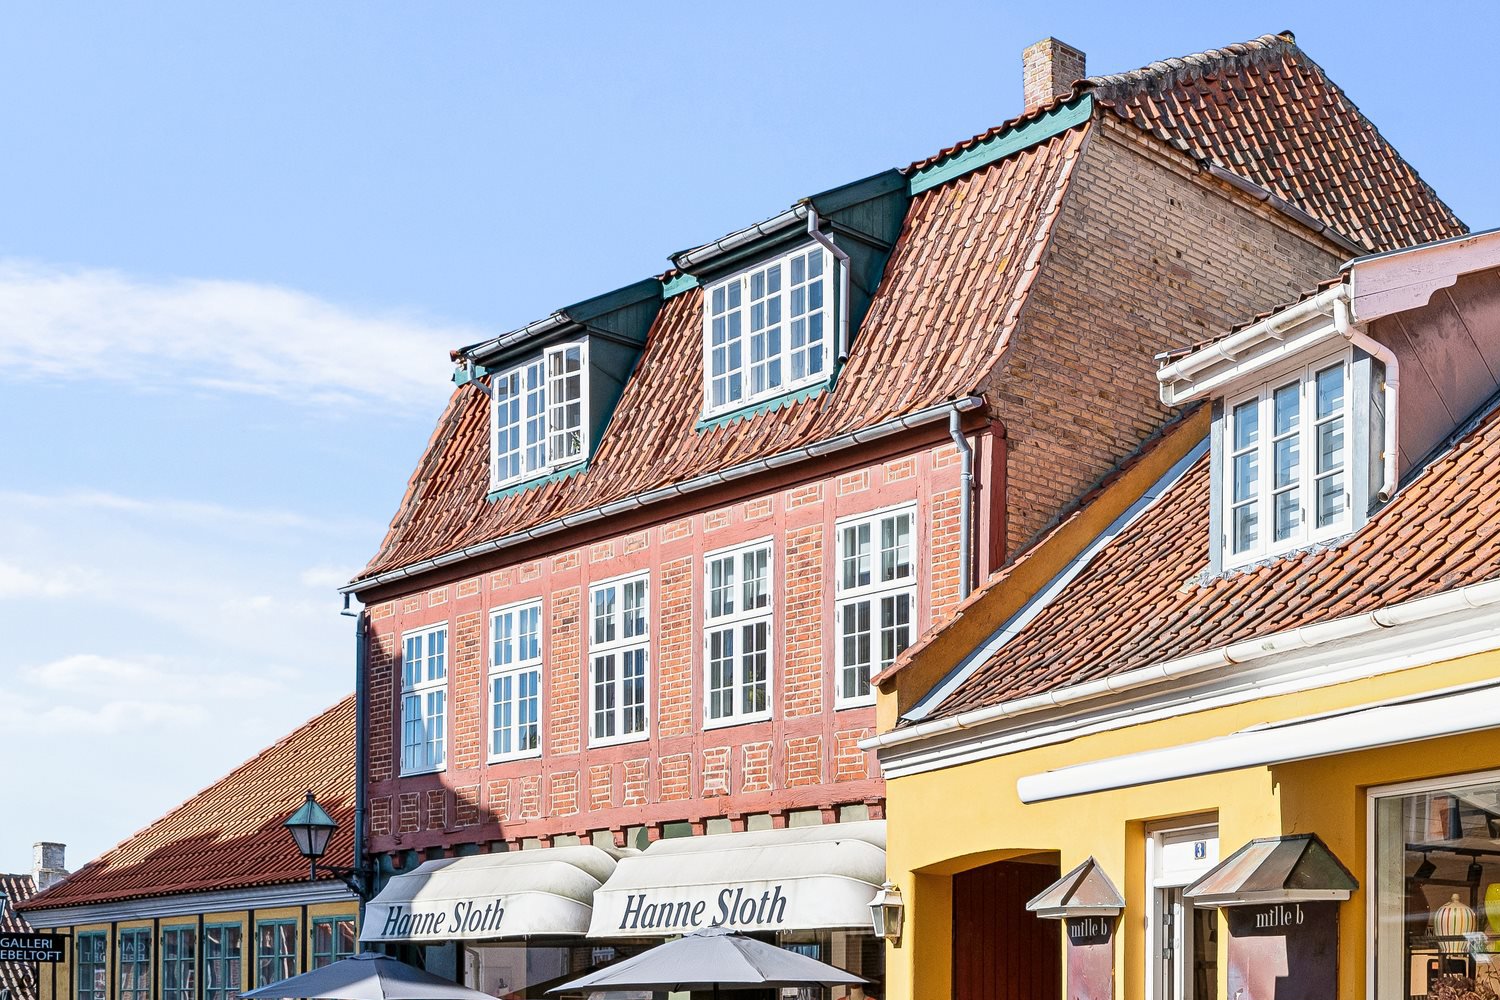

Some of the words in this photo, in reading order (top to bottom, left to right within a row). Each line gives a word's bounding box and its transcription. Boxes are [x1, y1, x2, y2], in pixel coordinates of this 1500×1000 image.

[380, 905, 446, 936] Hanne
[447, 898, 505, 934] Sloth
[618, 894, 706, 930] Hanne
[711, 884, 788, 927] Sloth
[1255, 905, 1292, 928] mille
[1295, 903, 1304, 925] b
[1070, 918, 1098, 938] mille
[1100, 917, 1108, 936] b
[0, 937, 53, 949] GALLERI
[0, 949, 62, 961] EBELTOFT
